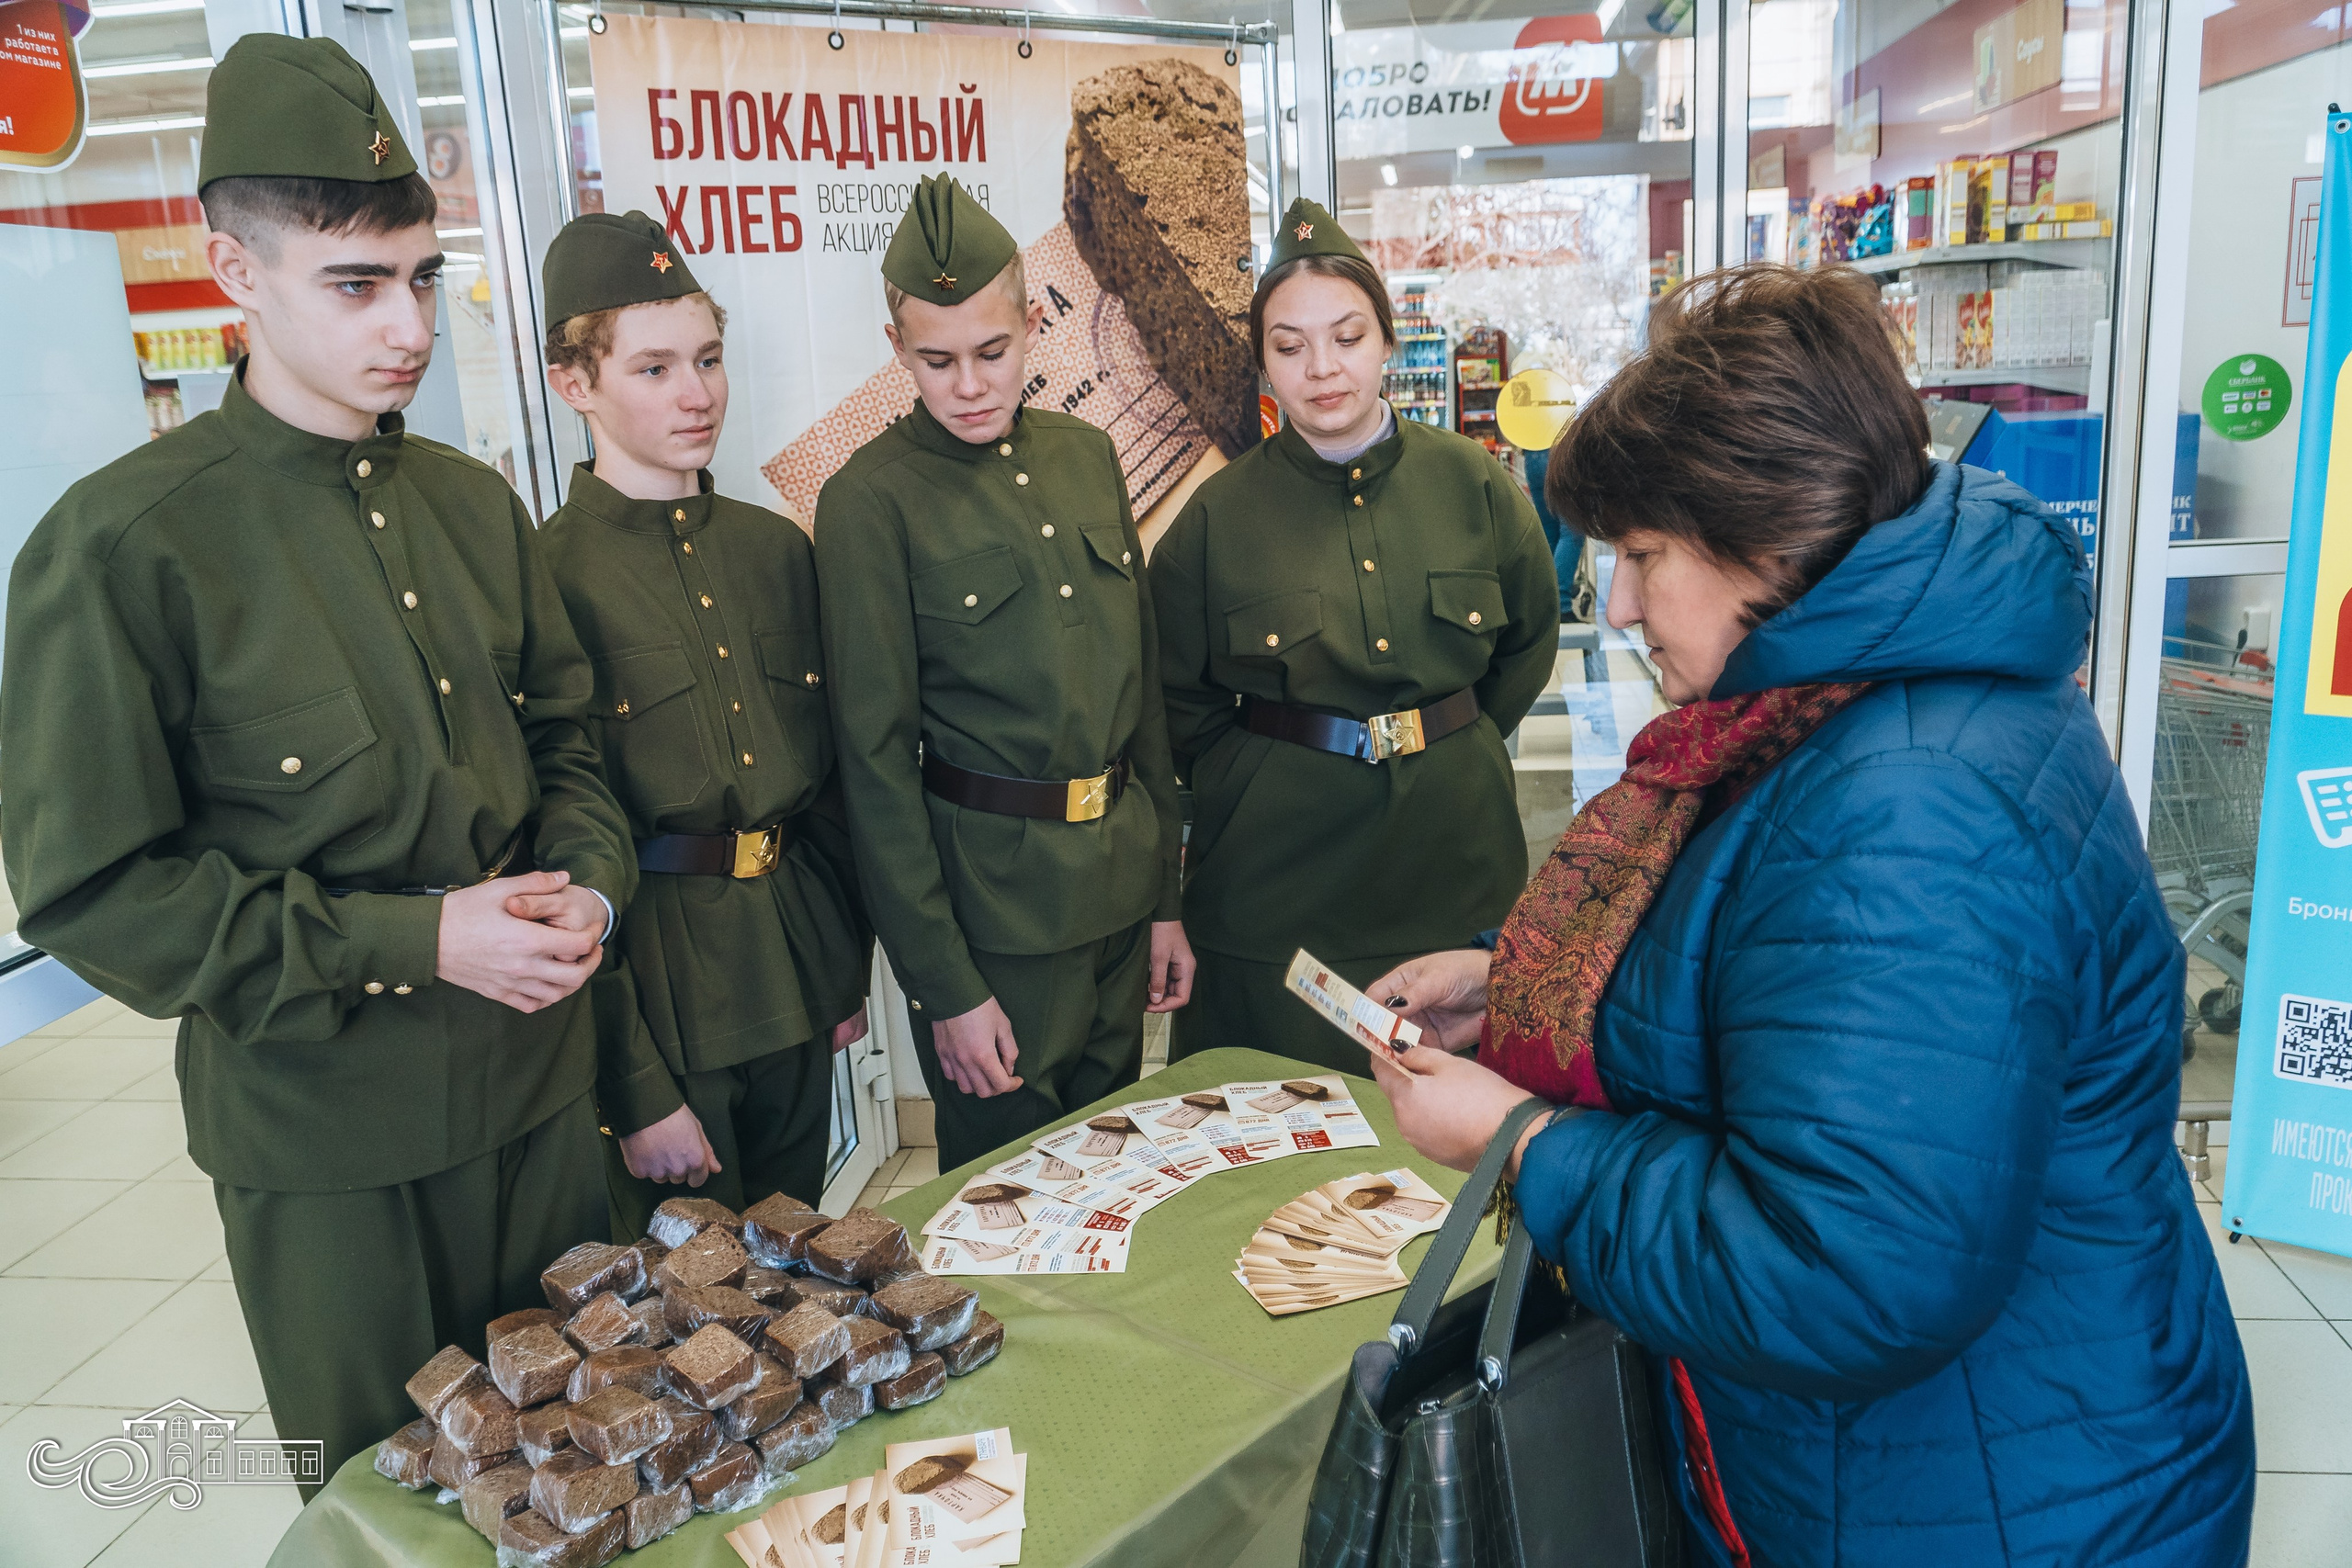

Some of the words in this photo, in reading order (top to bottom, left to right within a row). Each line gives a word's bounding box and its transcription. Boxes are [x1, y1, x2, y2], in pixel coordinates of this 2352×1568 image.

[5, 38, 51, 54] работает
[52, 47, 59, 55] в
[24, 28, 36, 38] из
[38, 30, 56, 41] них
[15, 53, 62, 70] магазине
[648, 83, 987, 170] БЛОКАДНЫЙ
[655, 185, 803, 254] ХЛЕБ
[823, 222, 894, 254] АКЦИЯ
[1020, 374, 1047, 404] ЛЕБ
[1061, 379, 1095, 413] 1942
[1097, 370, 1111, 383] г.
[2289, 897, 2352, 922] Брон
[933, 1491, 965, 1512] КАРТОЧКА
[907, 1506, 922, 1540] БЛОКАДНЫЙ
[924, 1524, 936, 1539] ХЛЕБ
[918, 1549, 931, 1565] ХЛЕБ
